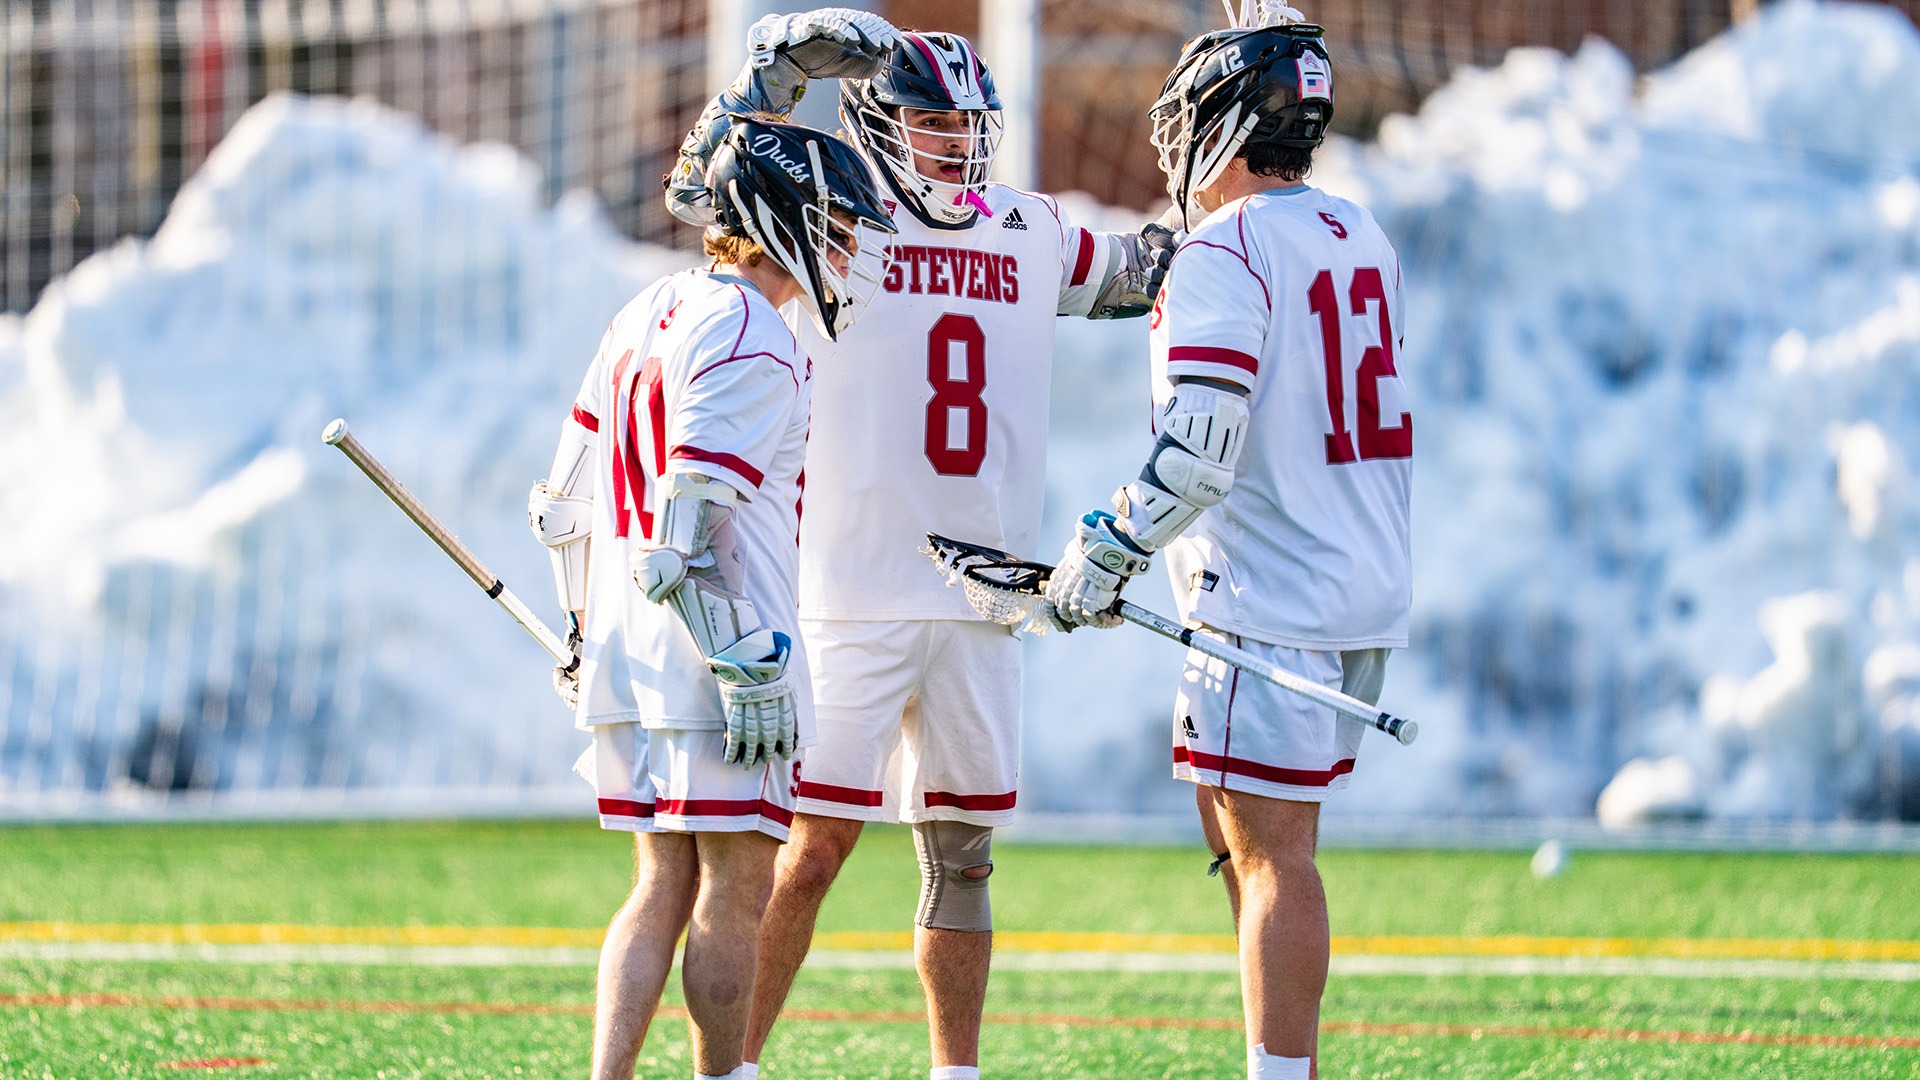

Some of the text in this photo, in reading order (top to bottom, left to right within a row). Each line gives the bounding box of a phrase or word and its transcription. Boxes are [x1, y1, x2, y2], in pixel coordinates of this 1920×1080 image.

[1219, 45, 1245, 77] 12
[751, 133, 810, 184] Ducks
[1002, 221, 1028, 231] adidas
[1317, 211, 1349, 240] S
[882, 244, 1019, 305] STEVENS
[1306, 266, 1413, 465] 12
[924, 311, 989, 477] 8
